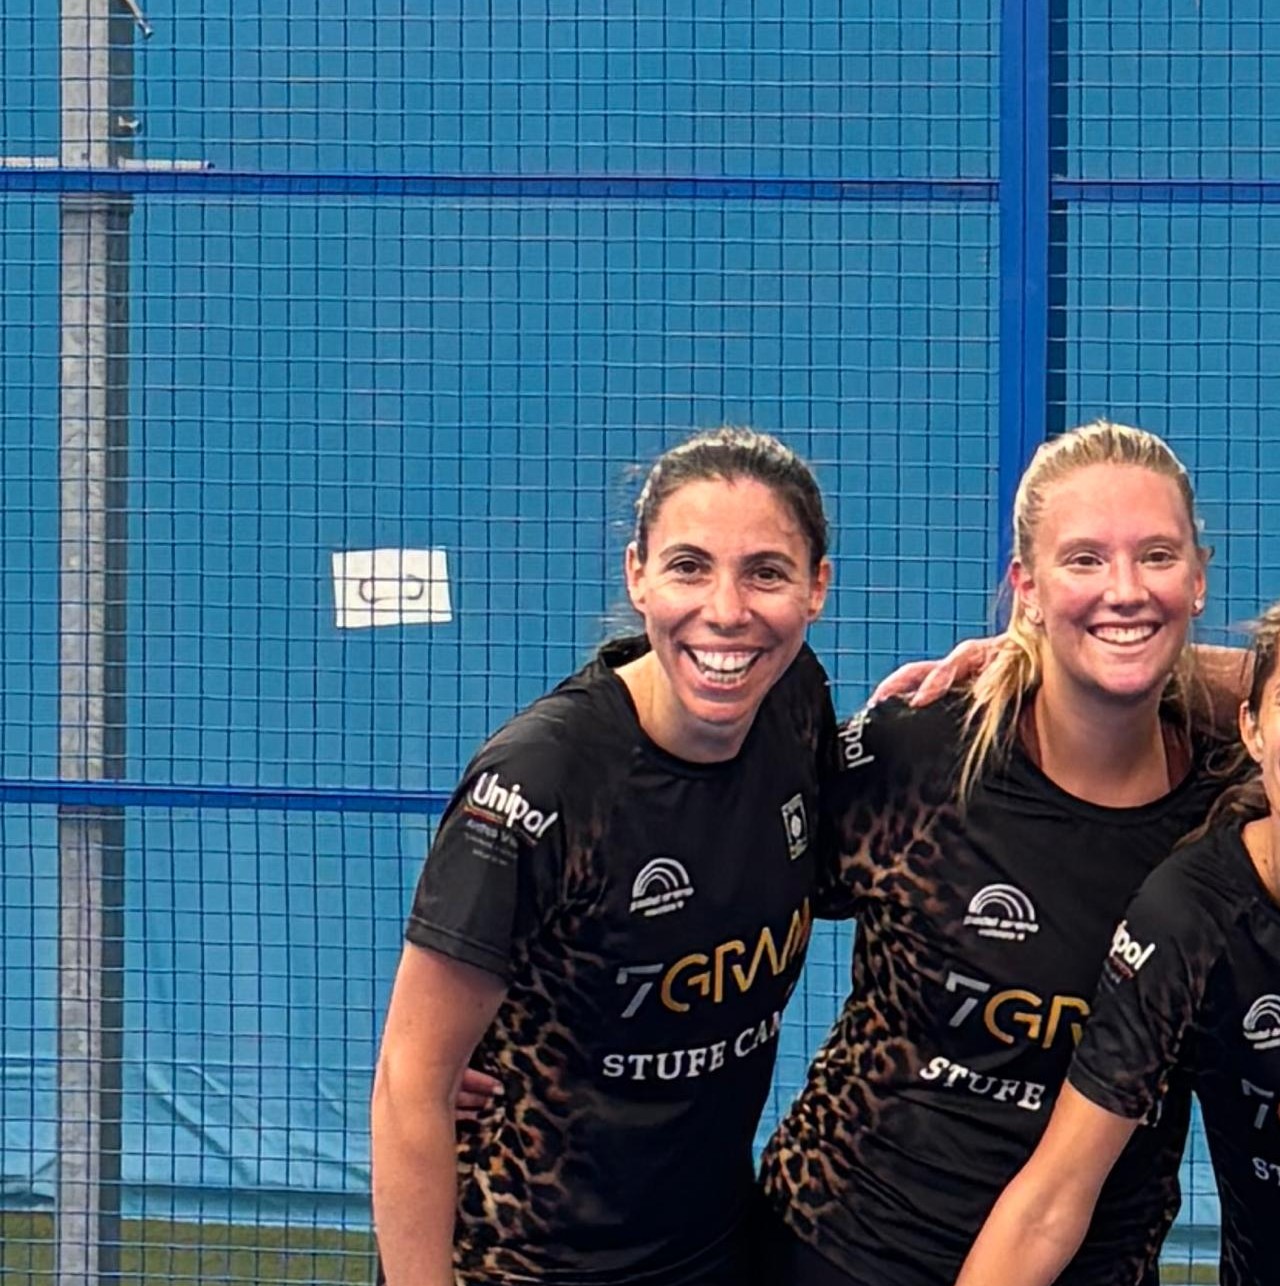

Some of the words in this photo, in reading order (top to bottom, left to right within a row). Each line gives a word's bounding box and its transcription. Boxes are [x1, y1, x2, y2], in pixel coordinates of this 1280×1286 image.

[472, 771, 559, 839] Unipol
[602, 1041, 727, 1081] STUFE
[919, 1056, 1047, 1112] STUFE
